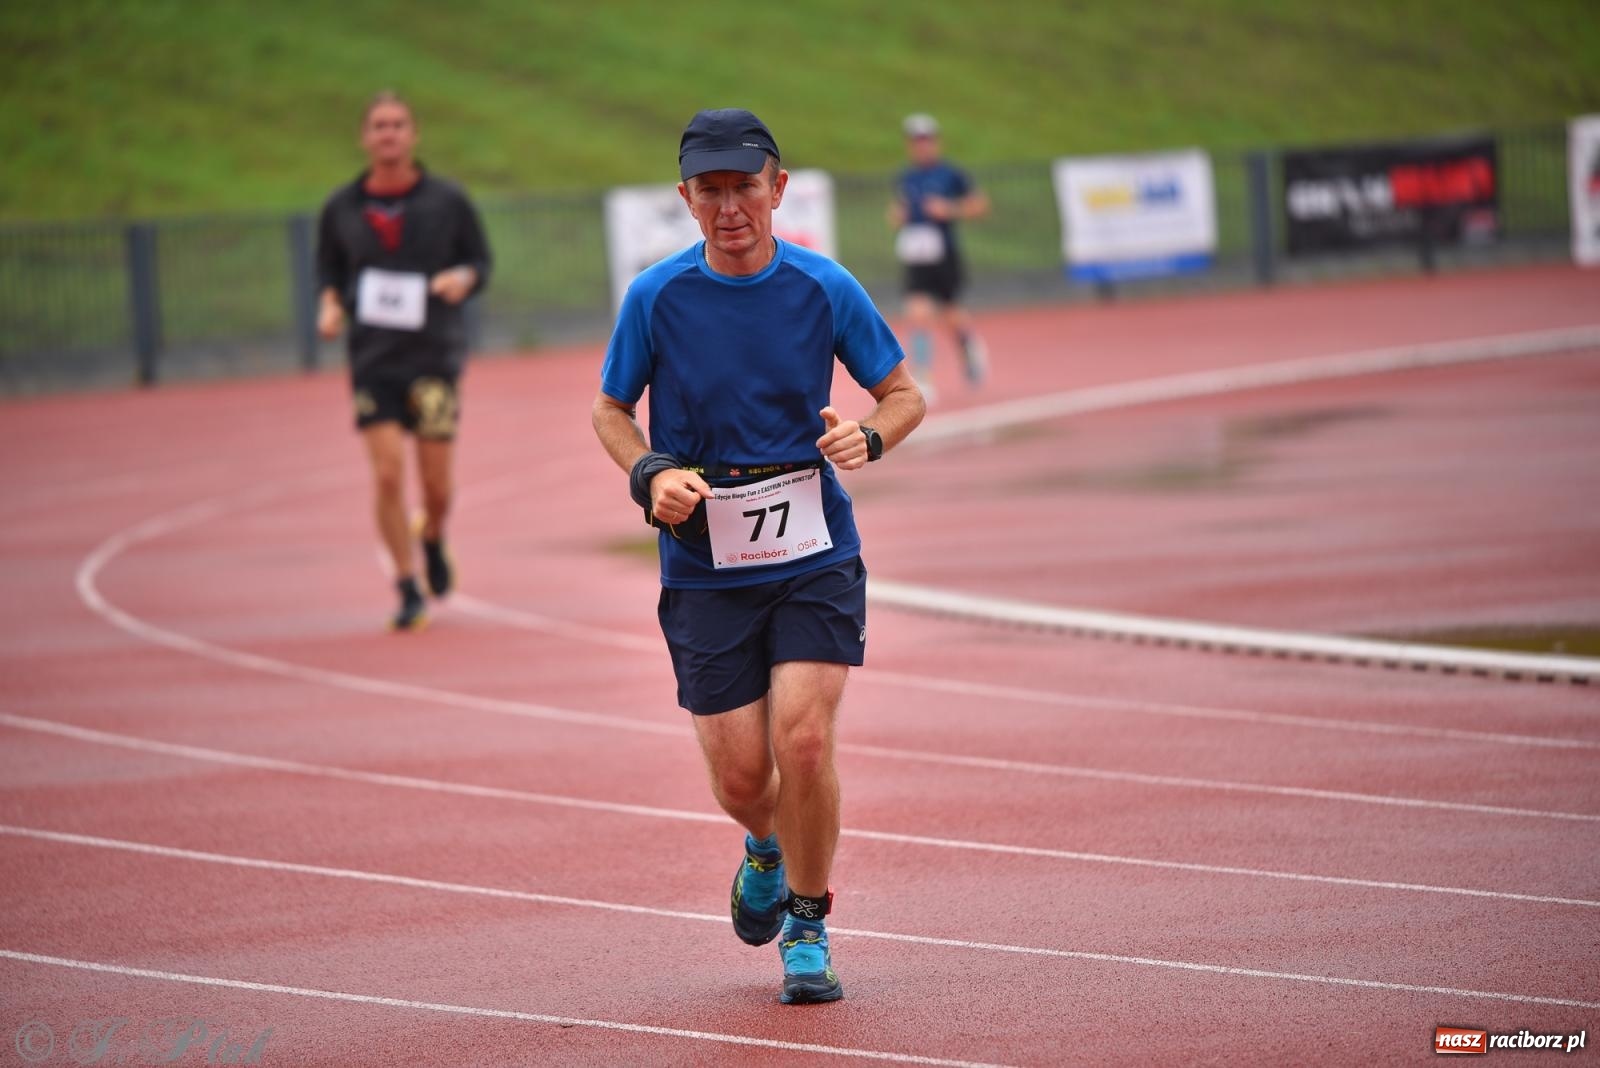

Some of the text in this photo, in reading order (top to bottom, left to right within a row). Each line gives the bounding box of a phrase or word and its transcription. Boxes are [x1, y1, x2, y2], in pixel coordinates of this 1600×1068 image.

[761, 482, 782, 494] EASYRUN
[742, 500, 790, 542] 77
[797, 538, 818, 552] OSiR
[741, 549, 788, 561] Racibórz
